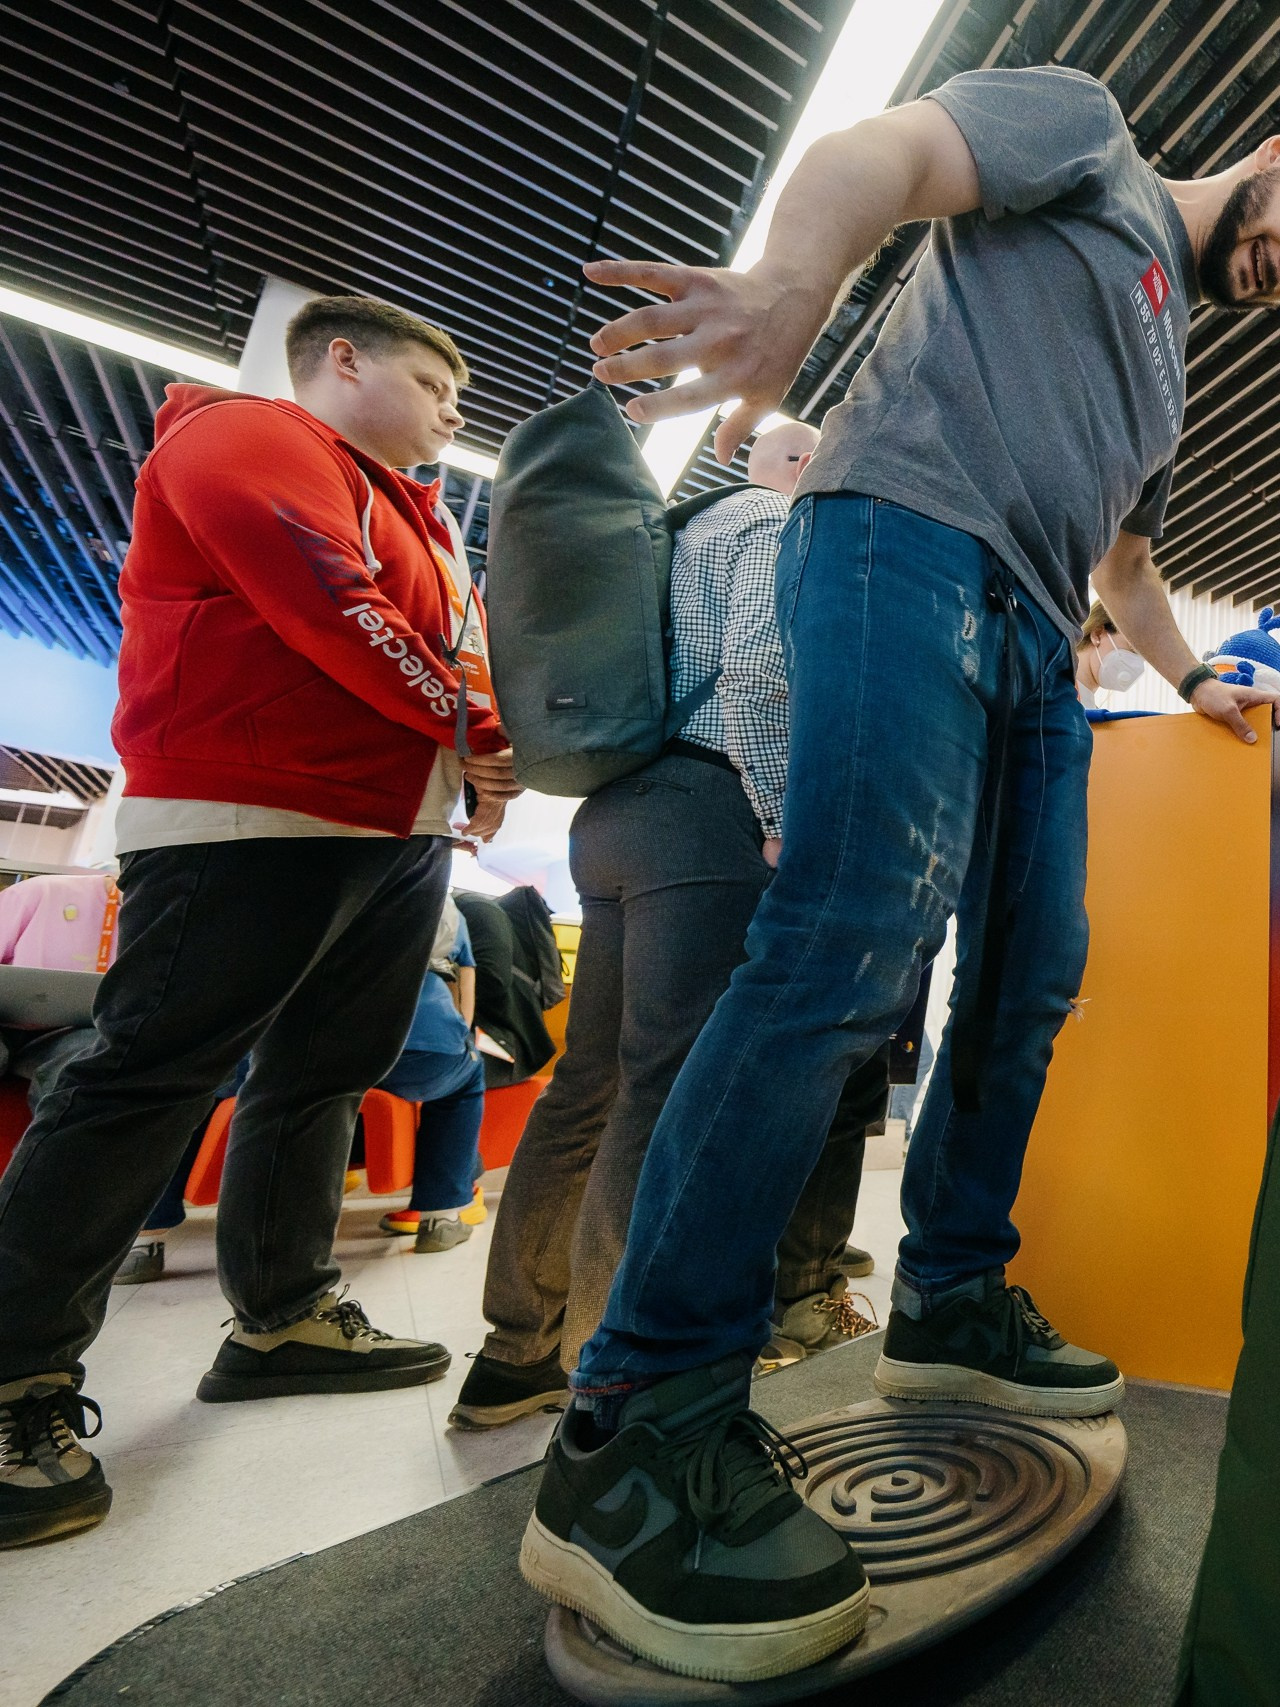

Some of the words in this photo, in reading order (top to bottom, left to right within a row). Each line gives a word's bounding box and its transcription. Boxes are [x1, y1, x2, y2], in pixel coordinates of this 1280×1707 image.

[1135, 289, 1144, 304] N
[1159, 368, 1166, 381] E
[1163, 308, 1181, 382] MOSCOW
[342, 602, 459, 717] Selectel
